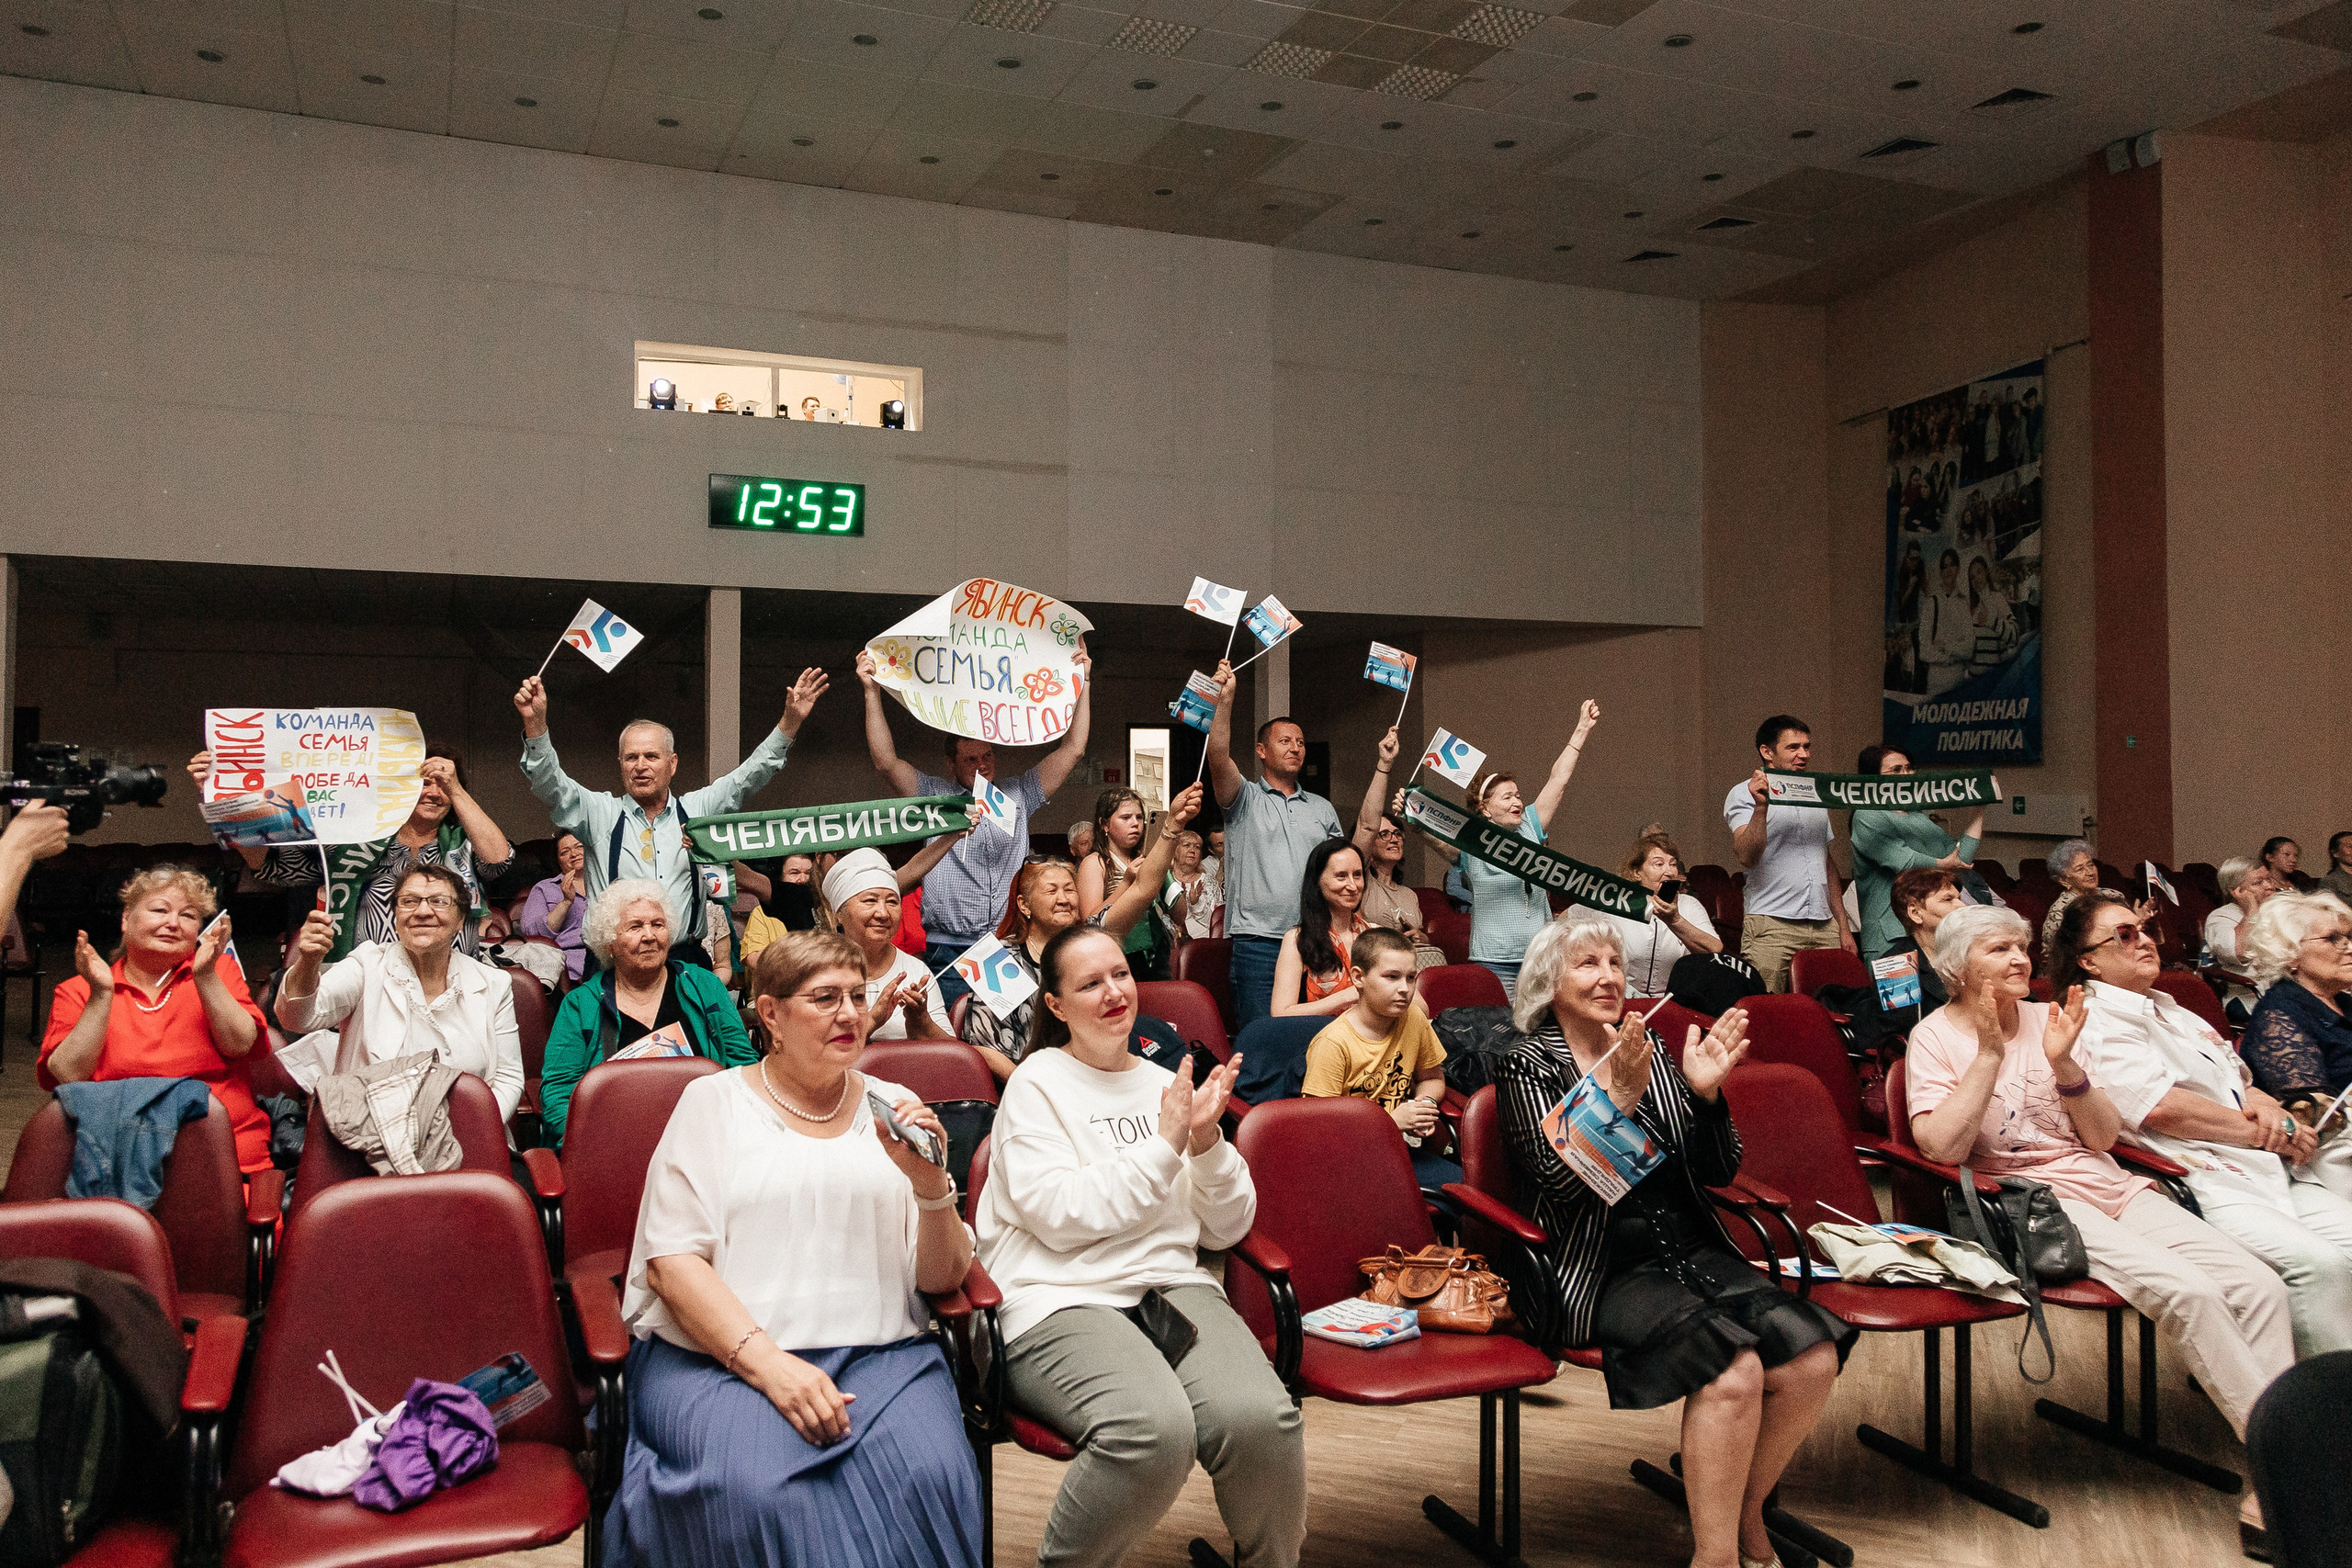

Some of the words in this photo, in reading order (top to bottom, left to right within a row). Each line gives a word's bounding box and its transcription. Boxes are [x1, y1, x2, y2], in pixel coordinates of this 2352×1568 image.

[738, 483, 856, 531] 12:53
[955, 579, 1055, 630] ЯБИНСК
[276, 713, 375, 731] КОМАНДА
[1912, 698, 2029, 725] МОЛОДЕЖНАЯ
[300, 734, 368, 751] СЕМЬЯ
[1937, 728, 2024, 751] ПОЛИТИКА
[307, 790, 338, 804] ВАС
[1830, 777, 1982, 805] ЧЕЛЯБИНСК
[709, 804, 950, 852] ЧЕЛЯБИНСК
[1427, 807, 1462, 826] ПСПФНР
[1478, 829, 1632, 912] ЧЕЛЯБИНСК
[1710, 953, 1751, 979] HEY
